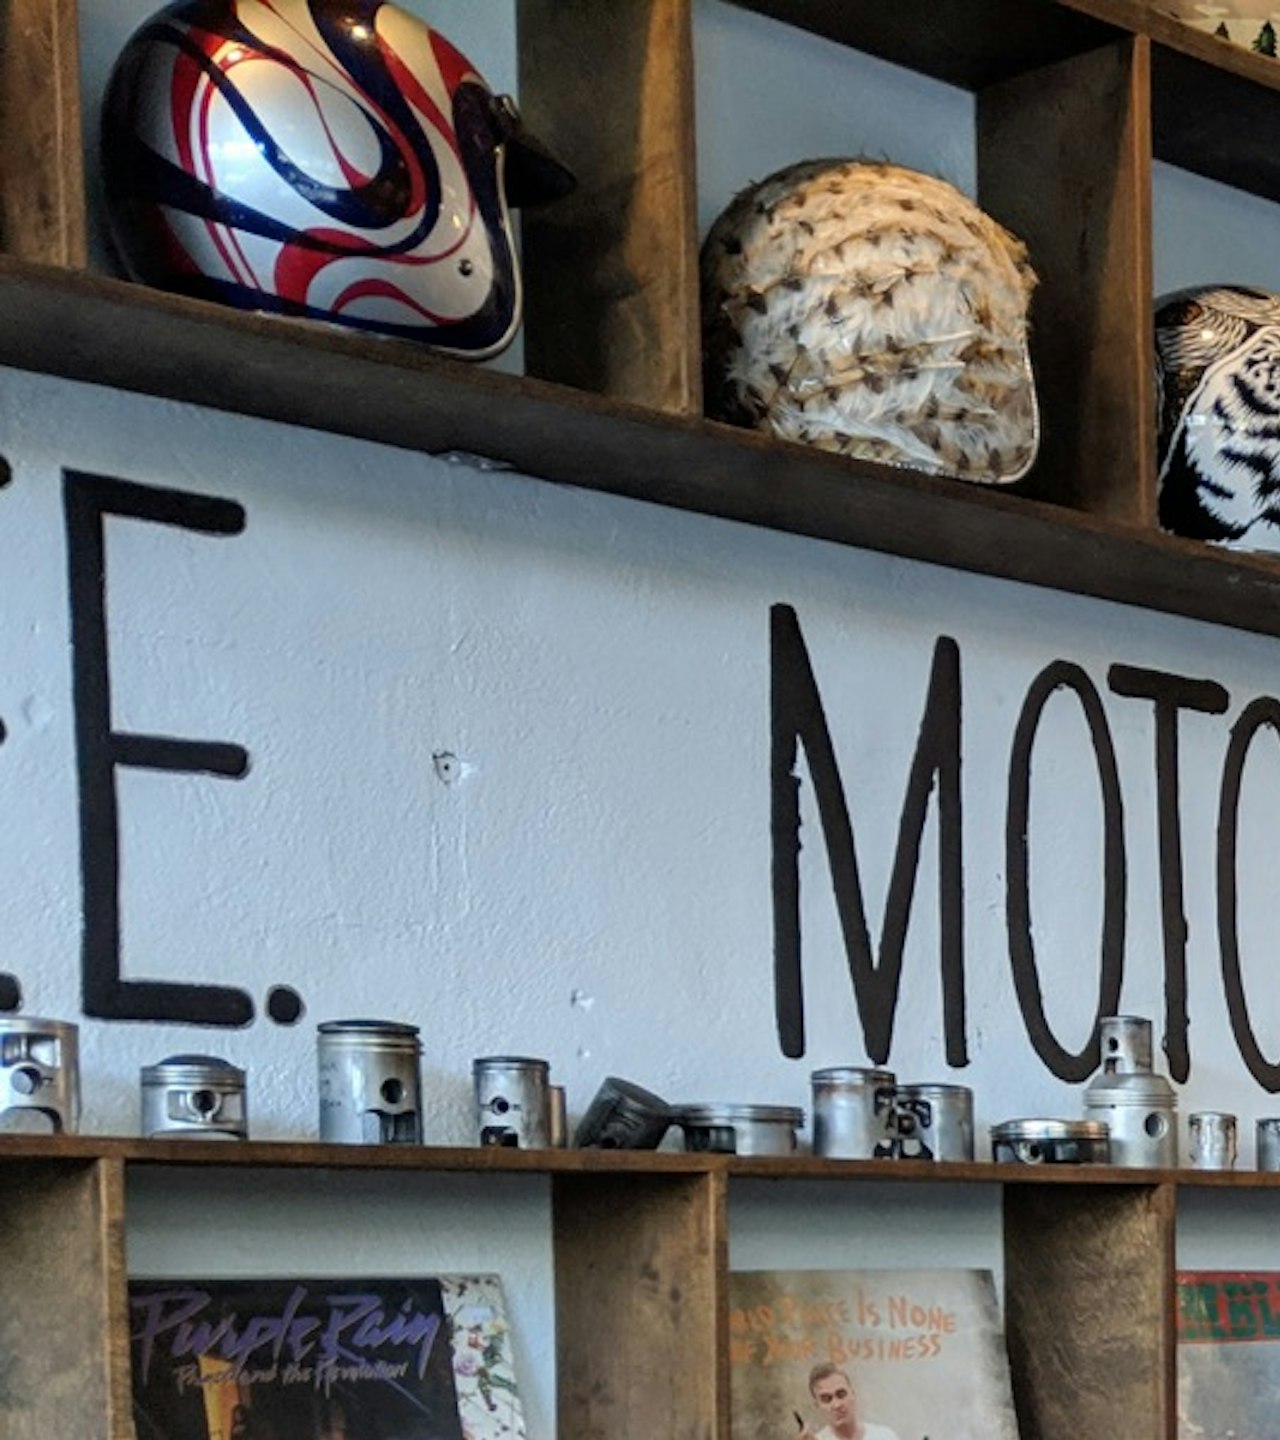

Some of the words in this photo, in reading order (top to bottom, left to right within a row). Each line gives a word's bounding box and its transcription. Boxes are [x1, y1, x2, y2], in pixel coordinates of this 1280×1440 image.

[0, 452, 304, 1028] E.
[130, 1285, 321, 1387] Purple
[321, 1296, 440, 1381] Rain
[829, 1332, 943, 1364] BUSINESS
[281, 1360, 312, 1385] the
